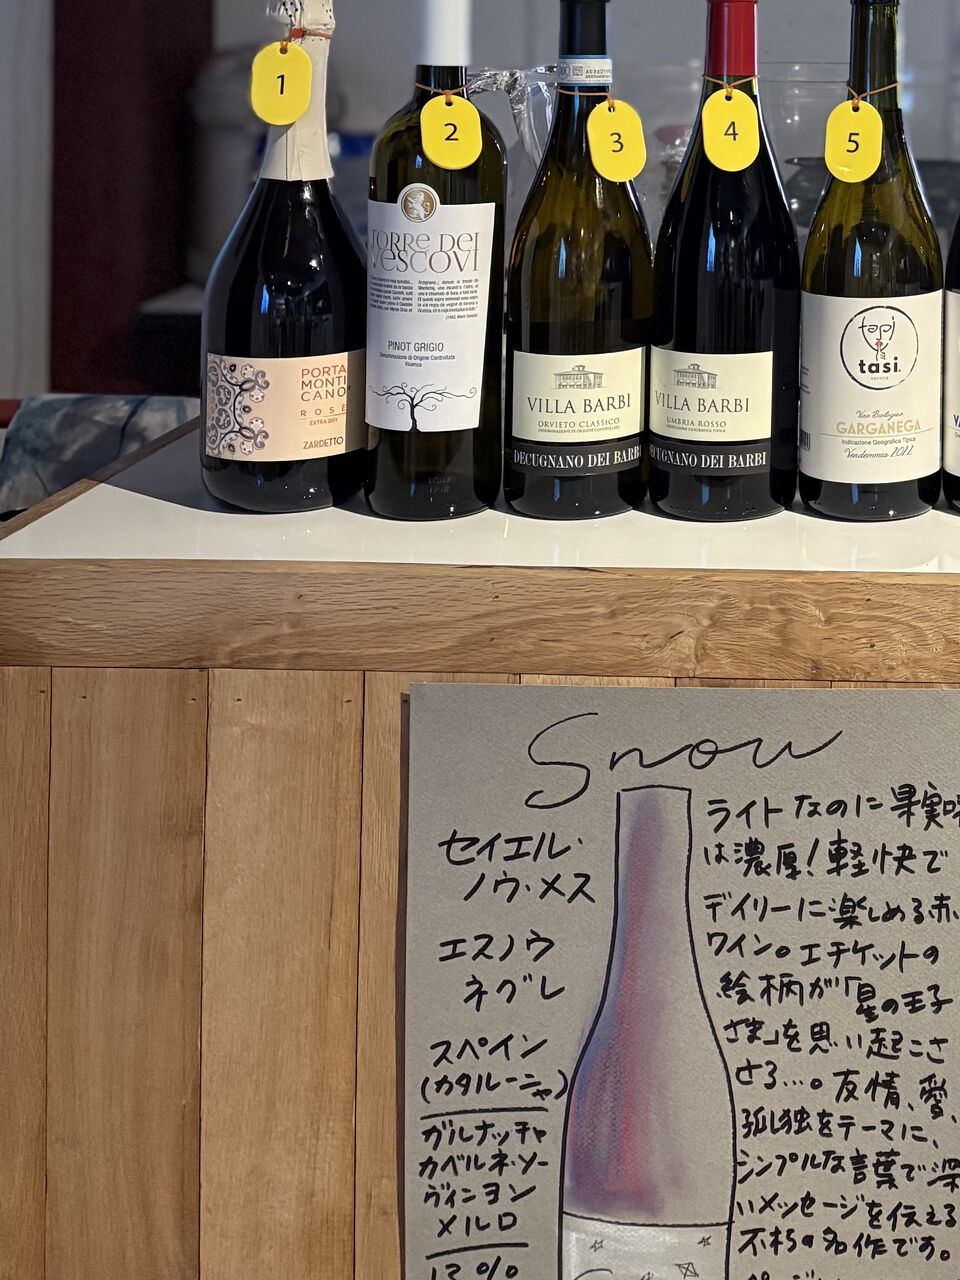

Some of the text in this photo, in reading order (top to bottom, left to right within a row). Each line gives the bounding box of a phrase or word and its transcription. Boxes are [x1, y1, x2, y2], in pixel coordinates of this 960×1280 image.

[275, 73, 286, 96] 1
[443, 122, 459, 142] 2
[723, 120, 739, 142] 4
[609, 131, 625, 153] 3
[845, 132, 860, 154] 5
[387, 340, 444, 352] PINOT GRIGIO
[301, 364, 346, 379] PORTA
[301, 375, 346, 391] MONTI
[300, 387, 346, 402] CANO
[527, 393, 631, 414] VILLA BARBI
[655, 390, 750, 413] VILLA BARBI
[300, 405, 347, 417] ROSÉ
[538, 418, 620, 429] ORVIETO CLASSICO
[666, 416, 727, 428] UMBRIA ROSSO
[836, 419, 921, 435] GARGANEGA
[302, 436, 344, 450] ZARDETTO
[872, 438, 902, 446] Geografica
[513, 449, 584, 469] DECUGNANO
[588, 451, 610, 467] DEI
[701, 453, 723, 468] DEI
[728, 452, 767, 469] BARBI
[844, 448, 889, 458] Vendemmia
[524, 711, 844, 810] Snow
[438, 930, 556, 964] エスノウ
[463, 974, 567, 1012] ネグレ
[429, 1034, 550, 1068] スペイン
[437, 1211, 518, 1237] メルロ
